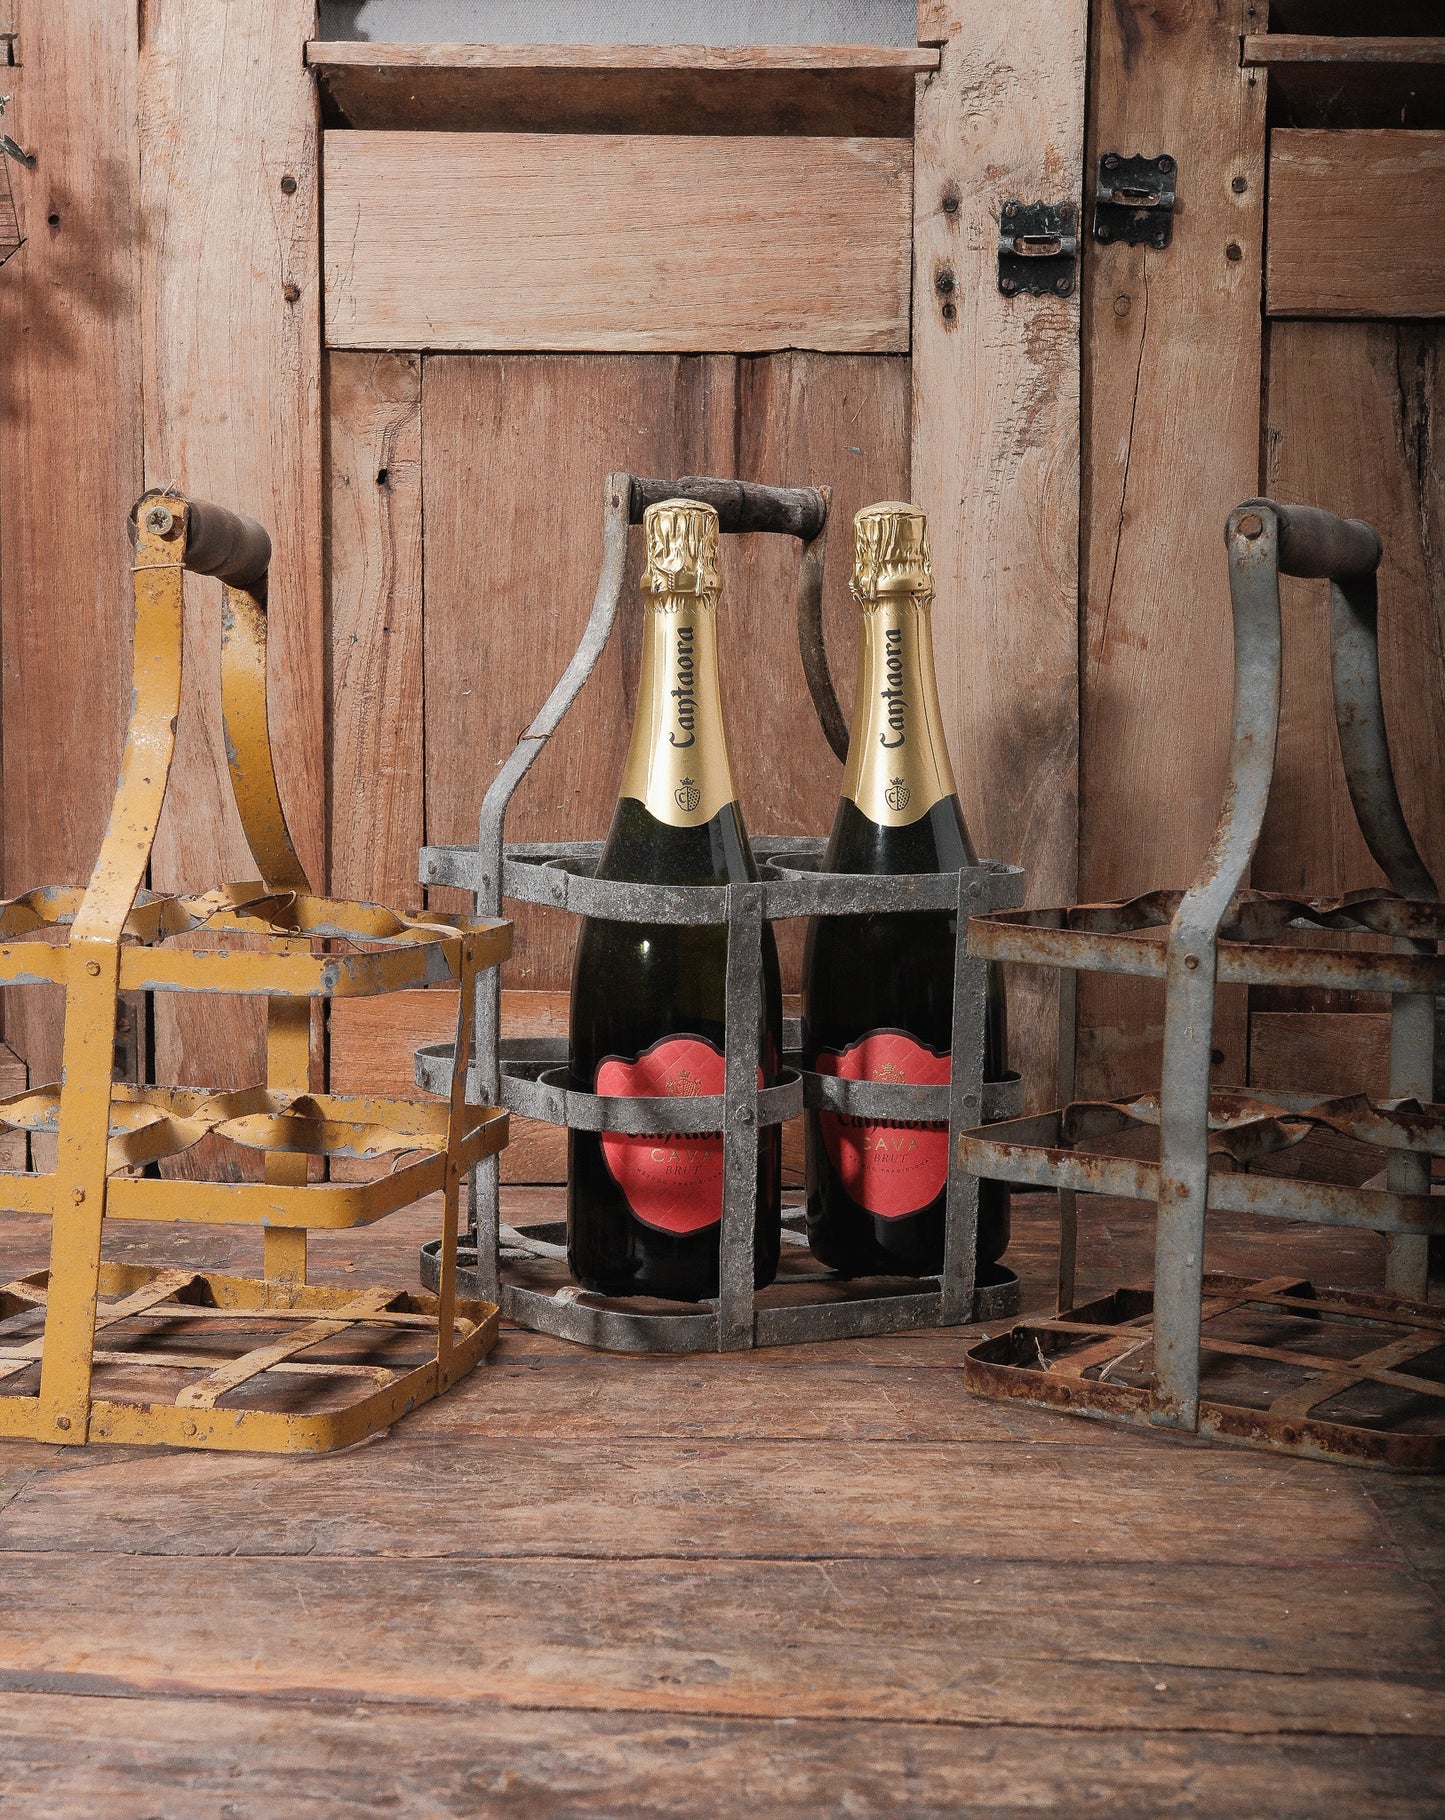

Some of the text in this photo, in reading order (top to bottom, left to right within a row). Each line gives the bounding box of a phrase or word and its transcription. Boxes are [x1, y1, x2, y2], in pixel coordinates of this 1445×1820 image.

[669, 626, 699, 748] Cantaora
[880, 628, 909, 749] Cantaora
[650, 1147, 714, 1163] CAVA
[873, 1152, 909, 1163] BRUT
[665, 1165, 702, 1176] BRUT
